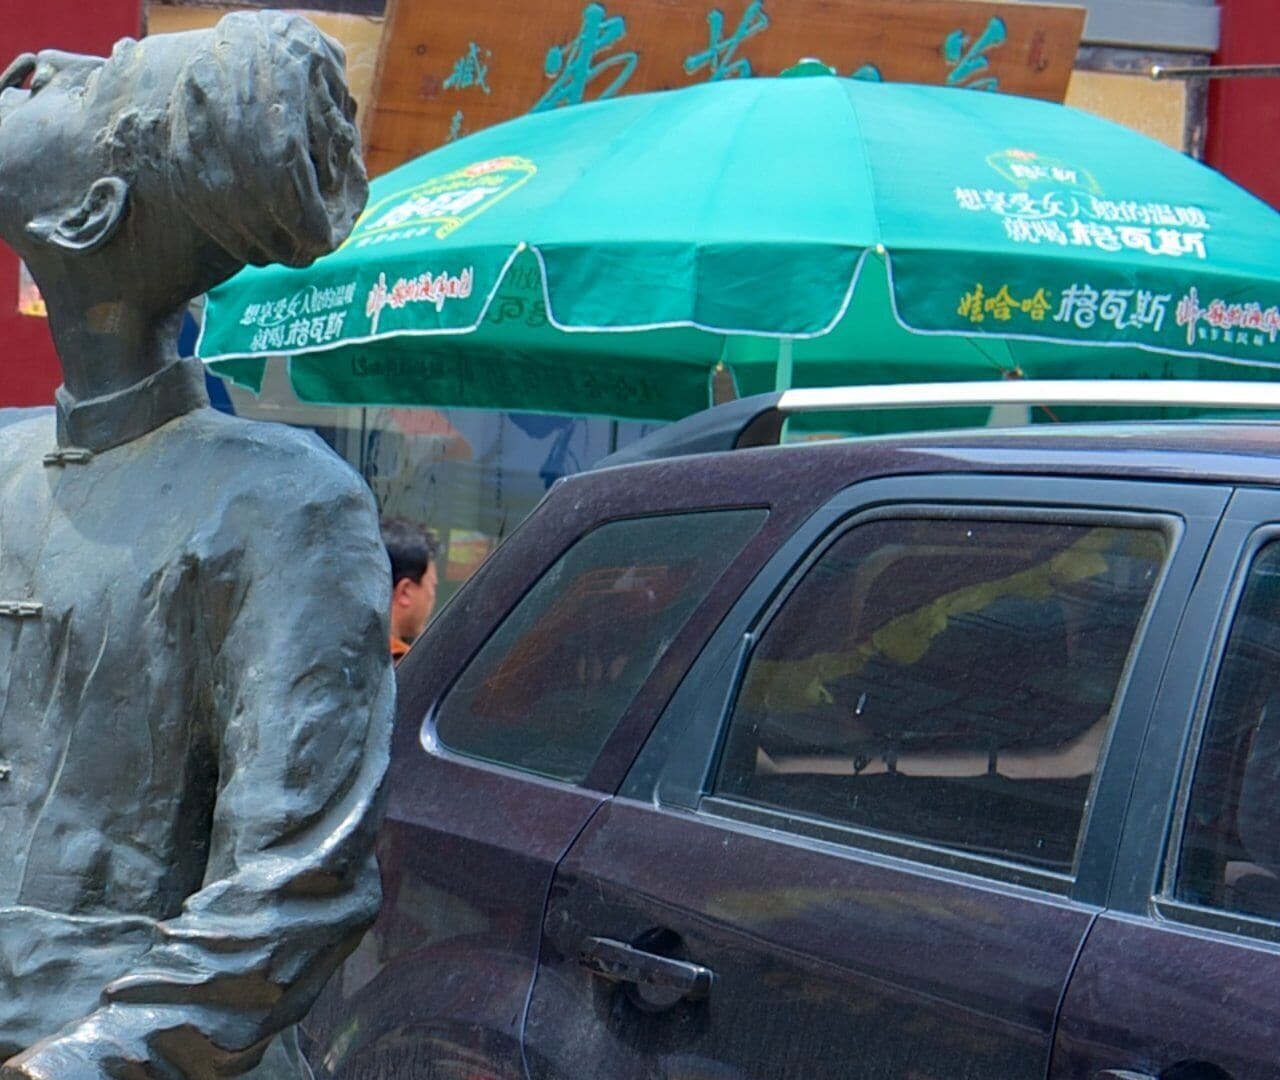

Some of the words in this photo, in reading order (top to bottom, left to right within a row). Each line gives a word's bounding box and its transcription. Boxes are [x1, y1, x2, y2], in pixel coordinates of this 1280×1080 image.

[956, 282, 1051, 323] 娃哈哈
[1053, 283, 1172, 332] 格瓦斯
